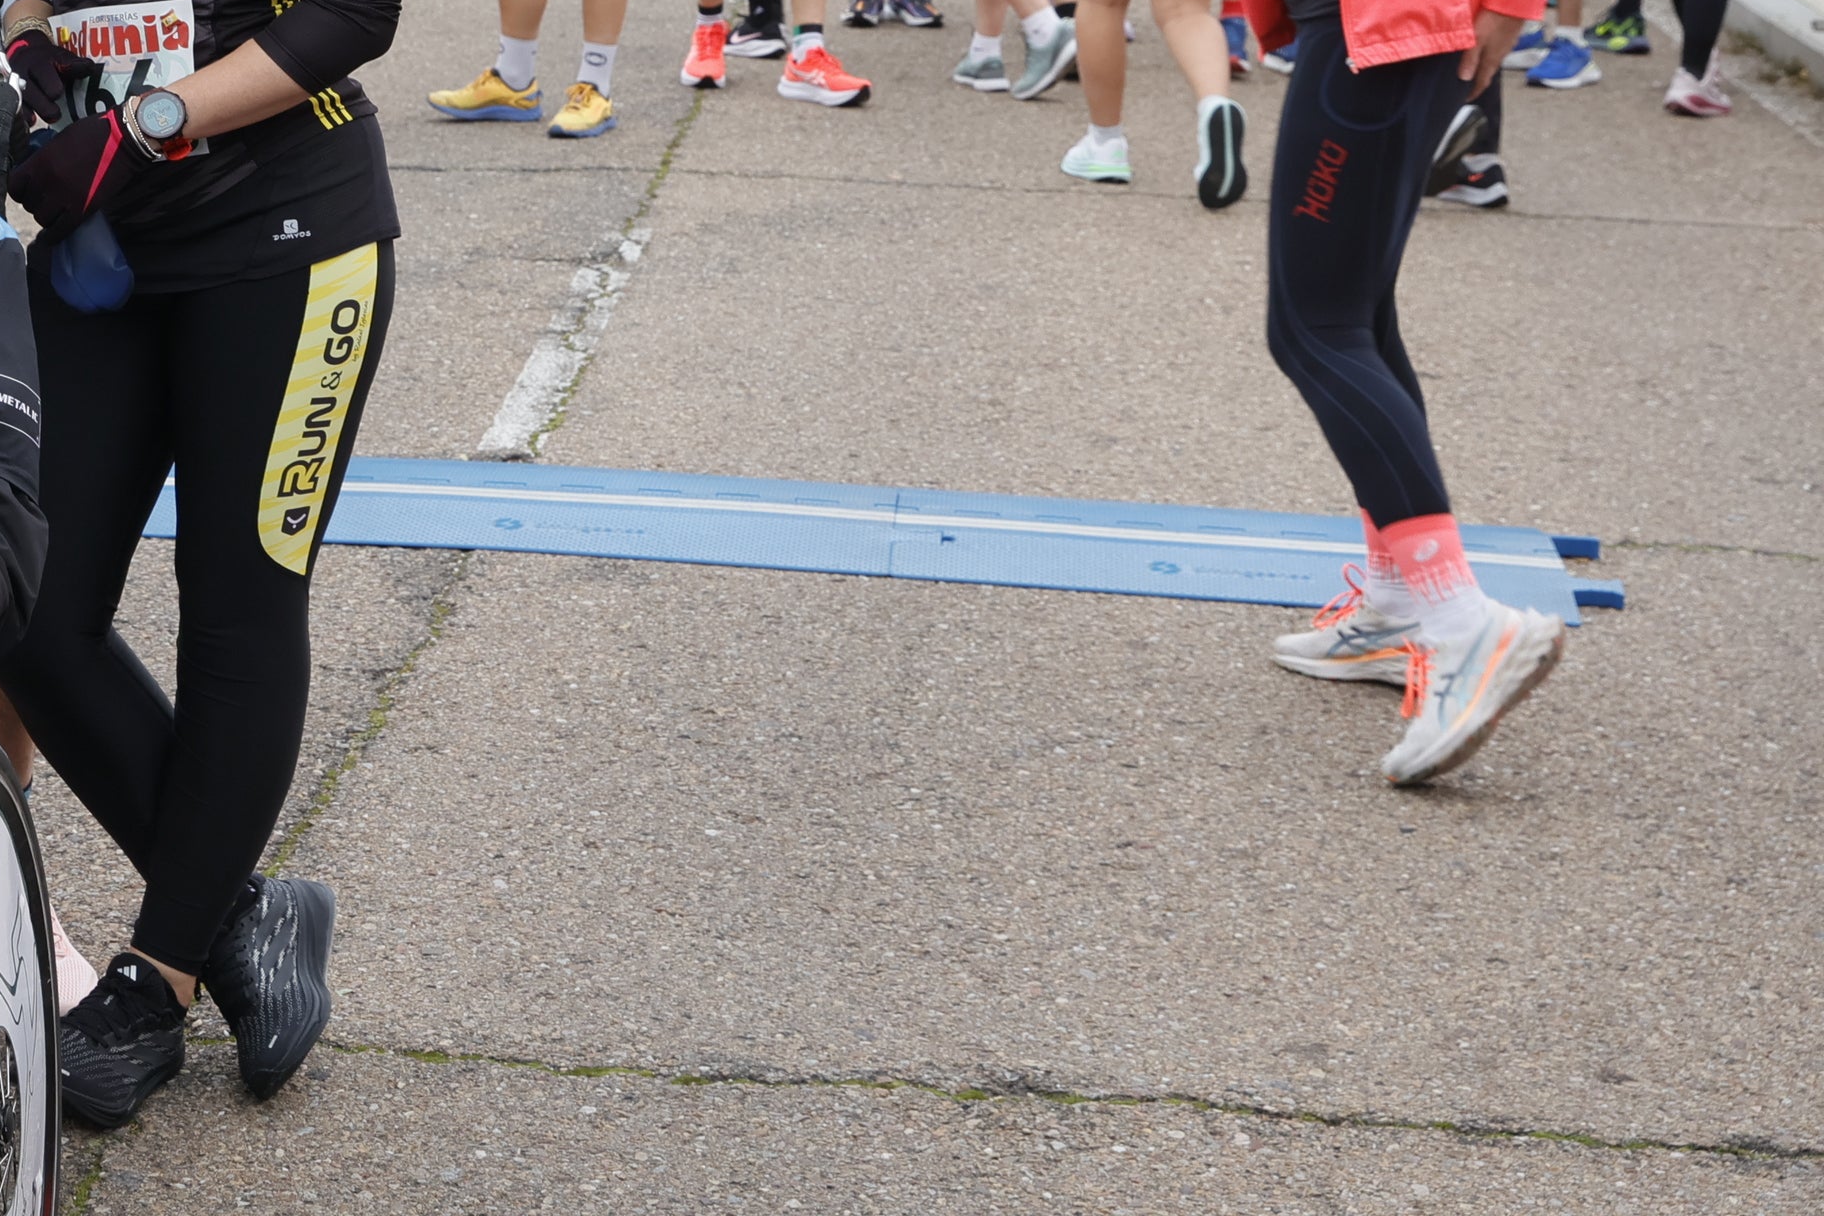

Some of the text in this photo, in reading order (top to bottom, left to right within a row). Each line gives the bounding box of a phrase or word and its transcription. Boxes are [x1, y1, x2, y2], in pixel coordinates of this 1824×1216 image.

[89, 12, 138, 24] FLORISTERÍAS
[272, 230, 312, 241] DOMYOS
[277, 299, 361, 498] RUN & GO
